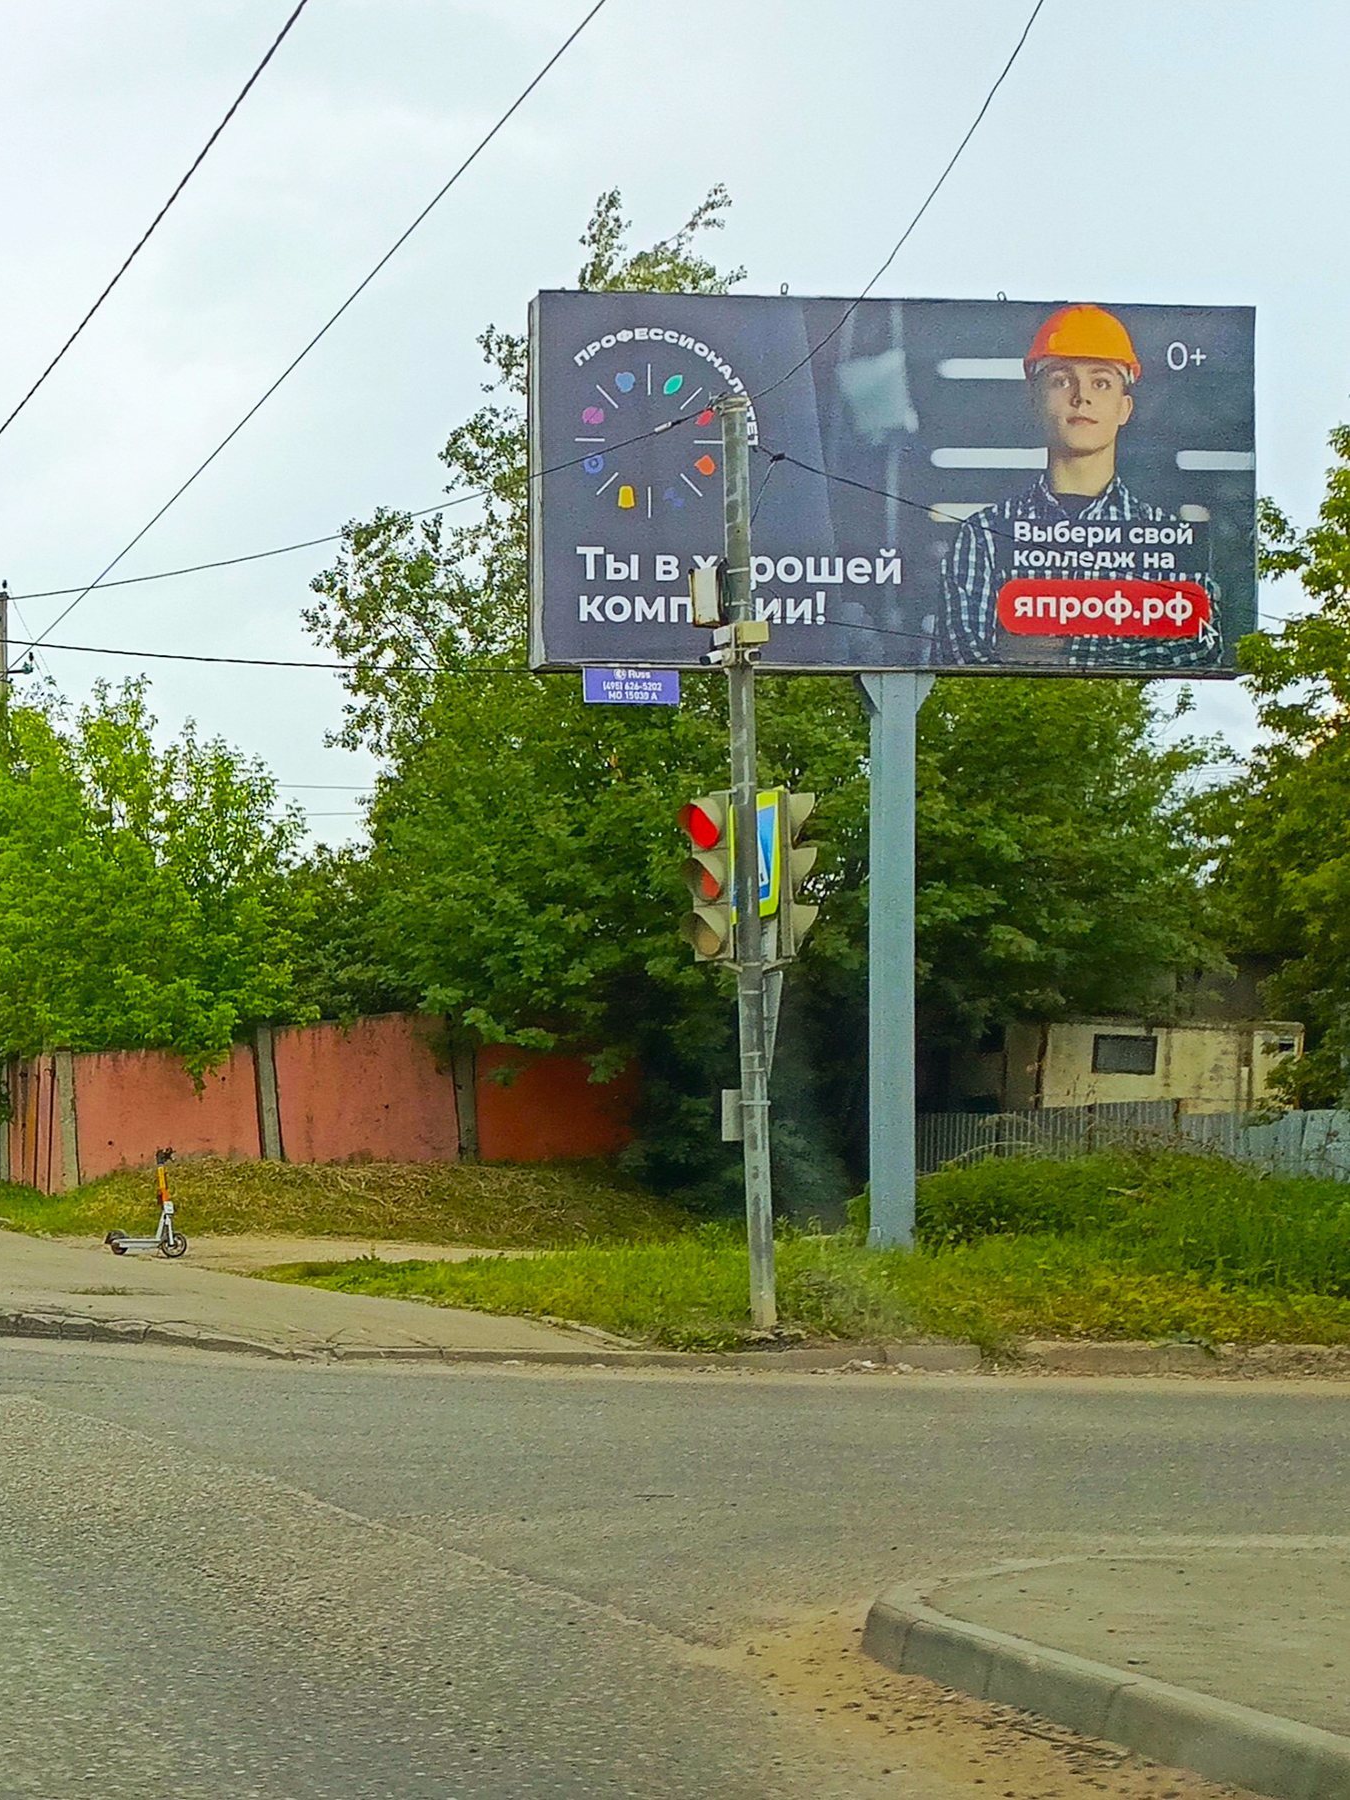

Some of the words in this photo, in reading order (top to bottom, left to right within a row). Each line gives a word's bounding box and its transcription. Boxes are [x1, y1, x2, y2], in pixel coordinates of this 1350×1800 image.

[1166, 341, 1207, 371] 0+
[1014, 520, 1121, 547] Выбери
[1128, 523, 1193, 545] свой
[576, 546, 639, 580] Ты
[655, 555, 679, 581] в
[1013, 550, 1135, 569] колледж
[1143, 551, 1175, 569] на
[578, 591, 826, 625] компии!
[1014, 590, 1193, 626] япроф.рф
